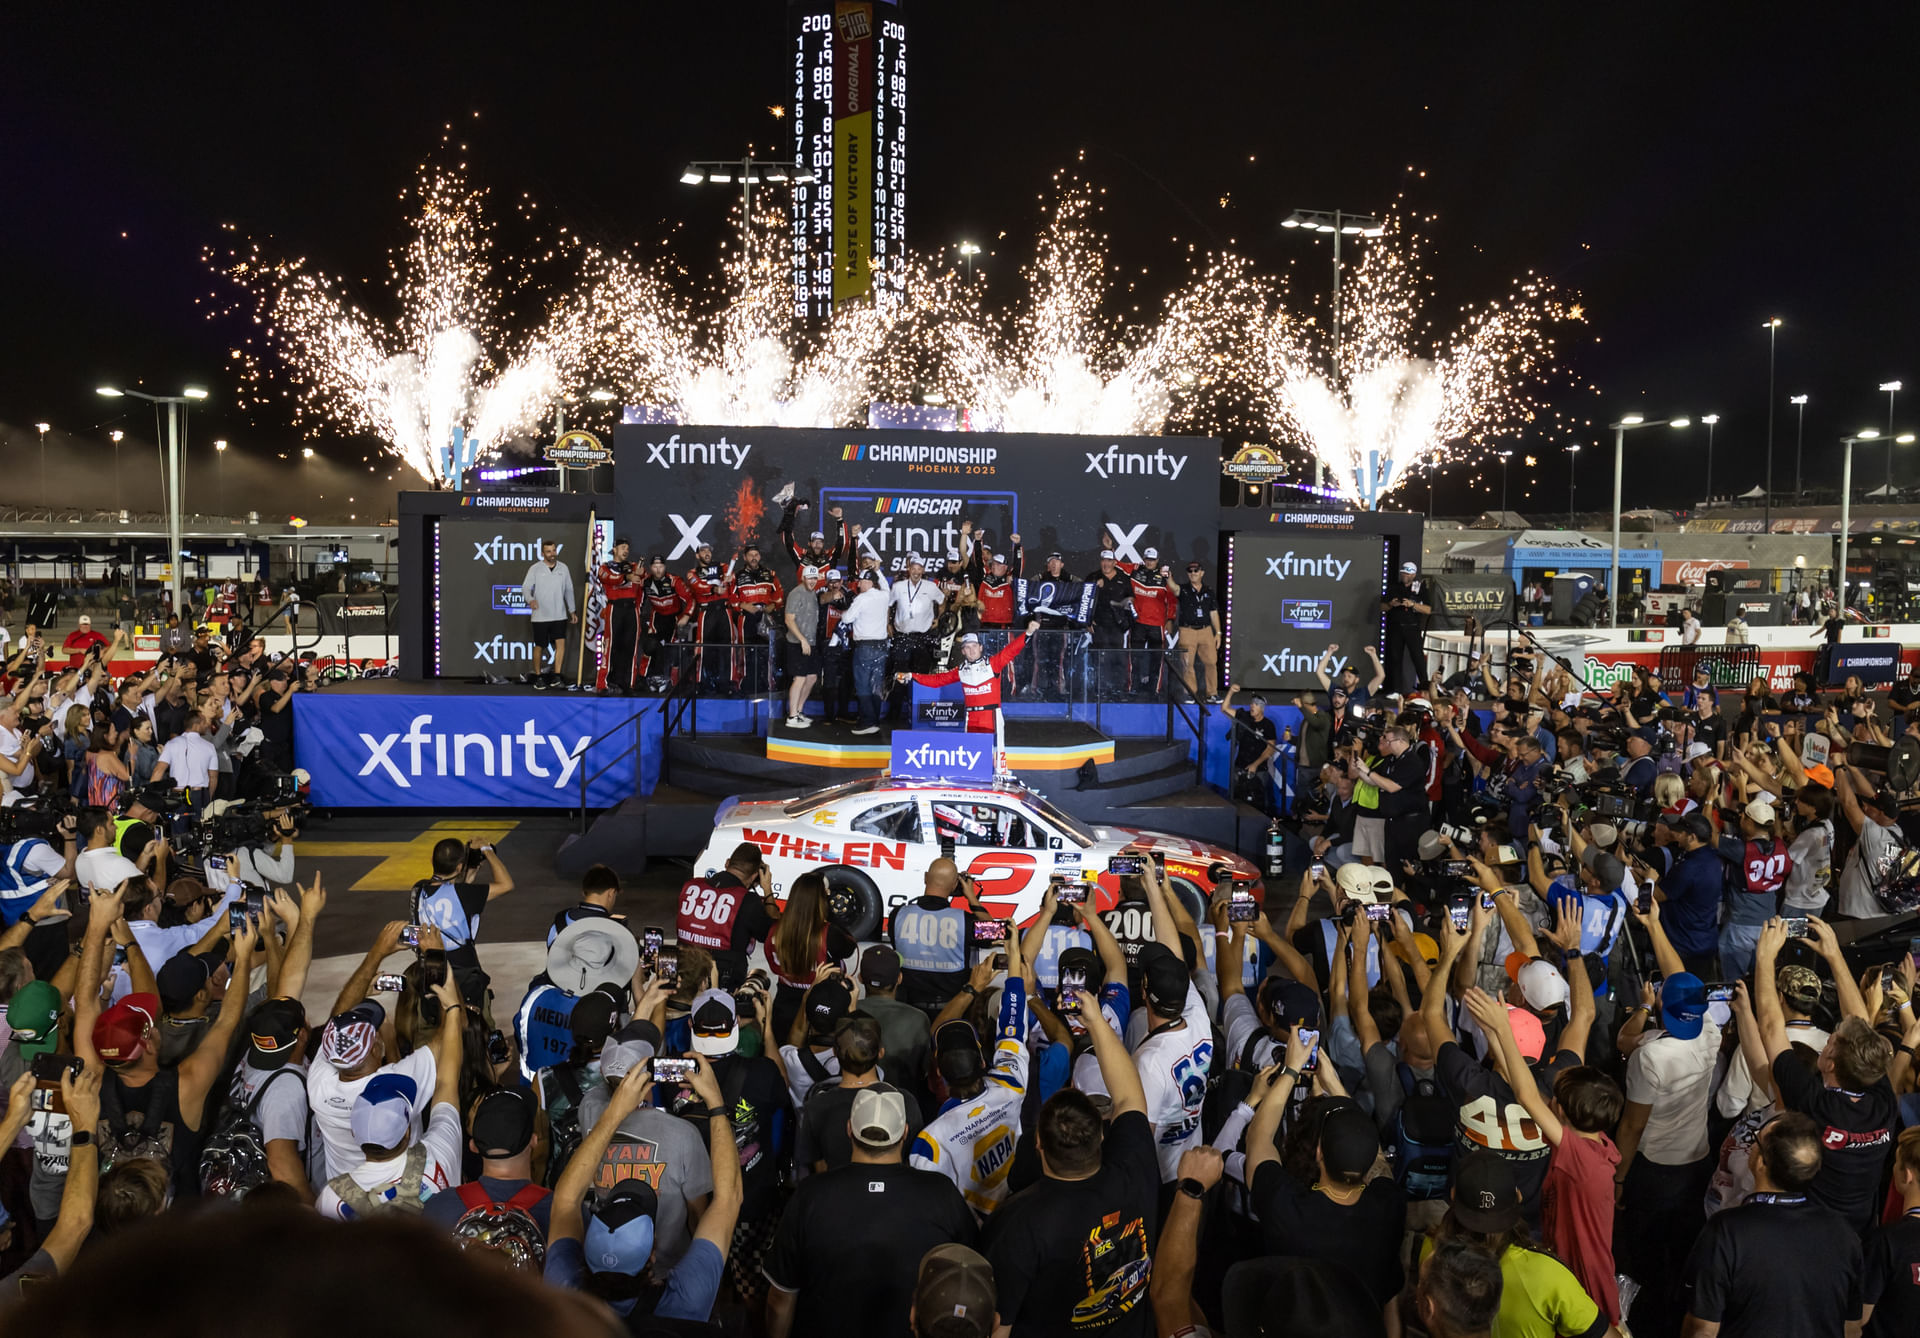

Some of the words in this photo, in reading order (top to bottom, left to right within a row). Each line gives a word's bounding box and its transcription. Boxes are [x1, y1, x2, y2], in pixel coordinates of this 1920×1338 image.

[802, 14, 831, 33] 200
[883, 20, 905, 41] 200
[796, 35, 803, 51] 1
[823, 32, 833, 49] 2
[878, 38, 885, 53] 1
[898, 43, 906, 59] 2
[795, 52, 804, 68] 2
[818, 49, 833, 65] 19
[877, 54, 885, 70] 2
[895, 60, 906, 75] 19
[795, 69, 804, 85] 3
[813, 66, 833, 83] 88
[848, 45, 859, 112] ORIGINAL
[877, 71, 885, 87] 3
[891, 75, 906, 93] 88
[795, 86, 804, 101] 4
[813, 83, 833, 100] 20
[877, 88, 885, 103] 4
[891, 91, 906, 109] 20
[795, 103, 804, 118] 5
[824, 100, 832, 115] 7
[877, 105, 884, 120] 5
[898, 110, 906, 125] 7
[795, 120, 804, 135] 6
[823, 117, 832, 133] 8
[877, 122, 884, 137] 6
[898, 126, 905, 142] 8
[795, 137, 804, 152] 7
[813, 135, 832, 151] 54
[877, 138, 884, 153] 7
[891, 141, 905, 158] 54
[813, 151, 832, 168] 00
[847, 133, 858, 200] VICTORY
[877, 155, 884, 170] 8
[890, 157, 905, 175] 00
[877, 172, 884, 187] 9
[890, 175, 905, 191] 21
[793, 186, 807, 201] 10
[818, 184, 832, 200] 18
[874, 188, 886, 203] 10
[894, 192, 905, 208] 18
[792, 203, 807, 218] 11
[813, 201, 832, 218] 25
[847, 206, 858, 224] OF
[874, 205, 886, 220] 11
[890, 207, 905, 224] 25
[792, 220, 807, 235] 12
[813, 218, 832, 234] 39
[874, 222, 886, 237] 12
[890, 224, 905, 240] 39
[847, 229, 858, 279] TASTE
[792, 270, 807, 285] 15
[813, 268, 832, 284] 48
[550, 449, 606, 460] CHAMPIONSHIP
[647, 434, 751, 469] xfinity
[869, 445, 997, 465] CHAMPIONSHIP
[908, 464, 960, 474] PHOENIX
[965, 466, 996, 475] 2025
[1085, 445, 1188, 480] xfinity
[1229, 464, 1283, 473] CHAMPIONSHIP
[476, 496, 550, 507] CHAMPIONSHIP
[896, 497, 962, 515] NASCAR
[1284, 513, 1355, 524] CHAMPIONSHIP
[667, 514, 712, 560] X
[1105, 523, 1149, 563] X
[474, 535, 563, 565] xfinit
[1265, 551, 1351, 581] xfinity
[1445, 590, 1505, 603] LEGACY
[1290, 606, 1324, 620] xfinity
[1775, 665, 1802, 676] AUTO
[1847, 657, 1893, 667] CHAMPIONSHIP
[1771, 678, 1798, 690] PART
[926, 706, 958, 719] xfinity
[357, 714, 592, 788] xfinity
[905, 743, 981, 770] xfinity
[742, 828, 907, 871] WHELEN
[966, 852, 1037, 923] 2
[680, 885, 736, 925] 336
[677, 928, 722, 948] TEAM/DRIVER
[901, 913, 958, 949] 408
[1460, 1094, 1548, 1151] 40
[606, 1145, 652, 1160] YAN
[977, 1135, 1013, 1179] NAPA
